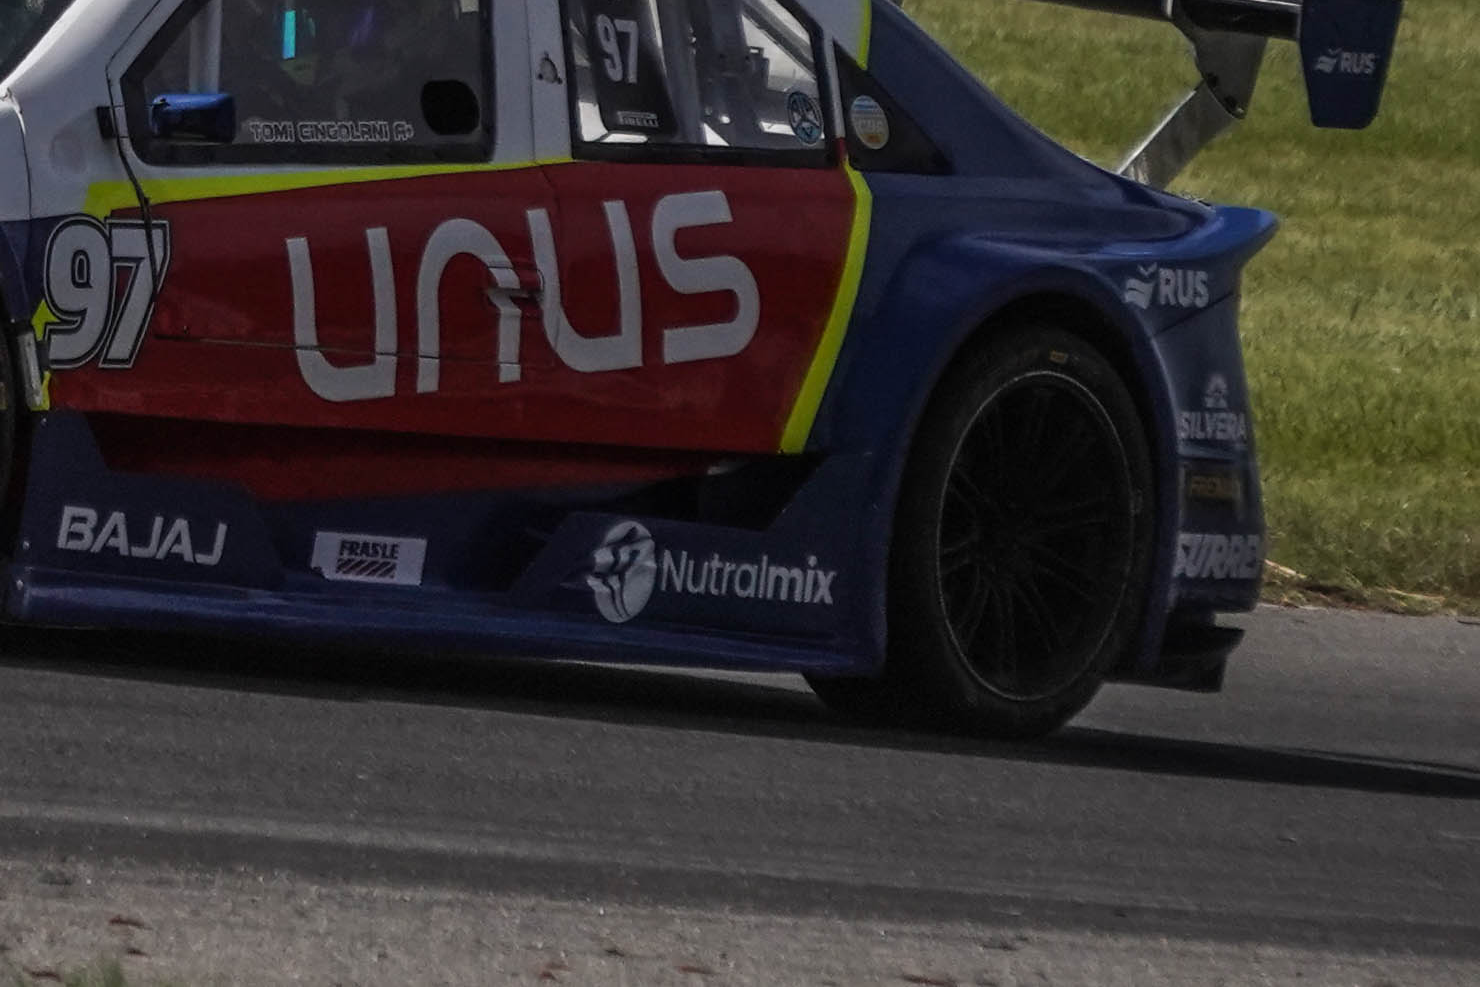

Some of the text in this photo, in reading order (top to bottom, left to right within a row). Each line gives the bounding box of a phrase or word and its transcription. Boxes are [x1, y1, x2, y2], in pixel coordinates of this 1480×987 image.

[596, 13, 639, 85] 97
[1341, 52, 1377, 74] RUS
[43, 213, 171, 369] 97
[1158, 267, 1210, 308] RUS
[56, 505, 228, 567] BAJAJ
[659, 548, 838, 606] Nutralmix
